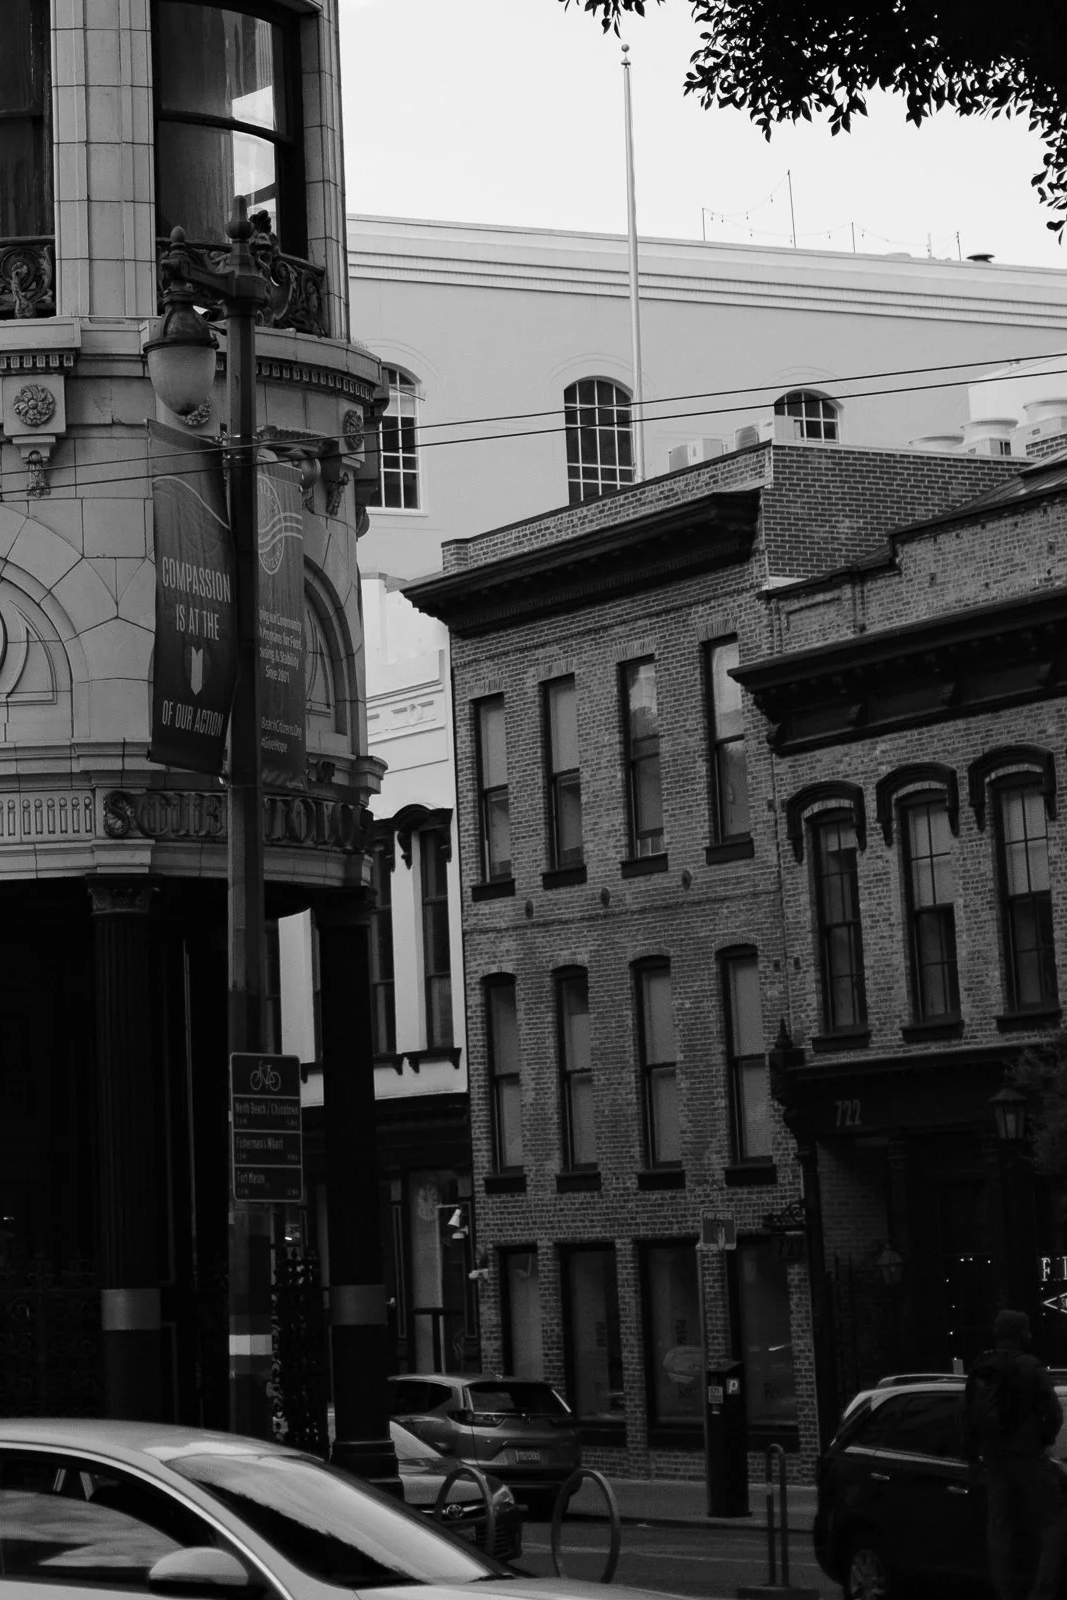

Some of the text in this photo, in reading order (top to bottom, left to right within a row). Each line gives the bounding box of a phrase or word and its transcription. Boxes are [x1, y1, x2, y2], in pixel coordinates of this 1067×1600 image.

[162, 556, 231, 603] COMPASSION
[176, 604, 219, 641] IS AT THE
[277, 613, 302, 635] Community
[263, 626, 282, 644] Programs
[280, 650, 299, 670] Stability
[162, 700, 224, 737] OF OUR ACTION
[235, 1102, 249, 1114] North
[250, 1102, 266, 1115] Beach
[271, 1102, 299, 1116] Chinatown
[835, 1099, 862, 1127] 722
[267, 1137, 283, 1150] Wharf
[237, 1171, 266, 1185] Fort Mason
